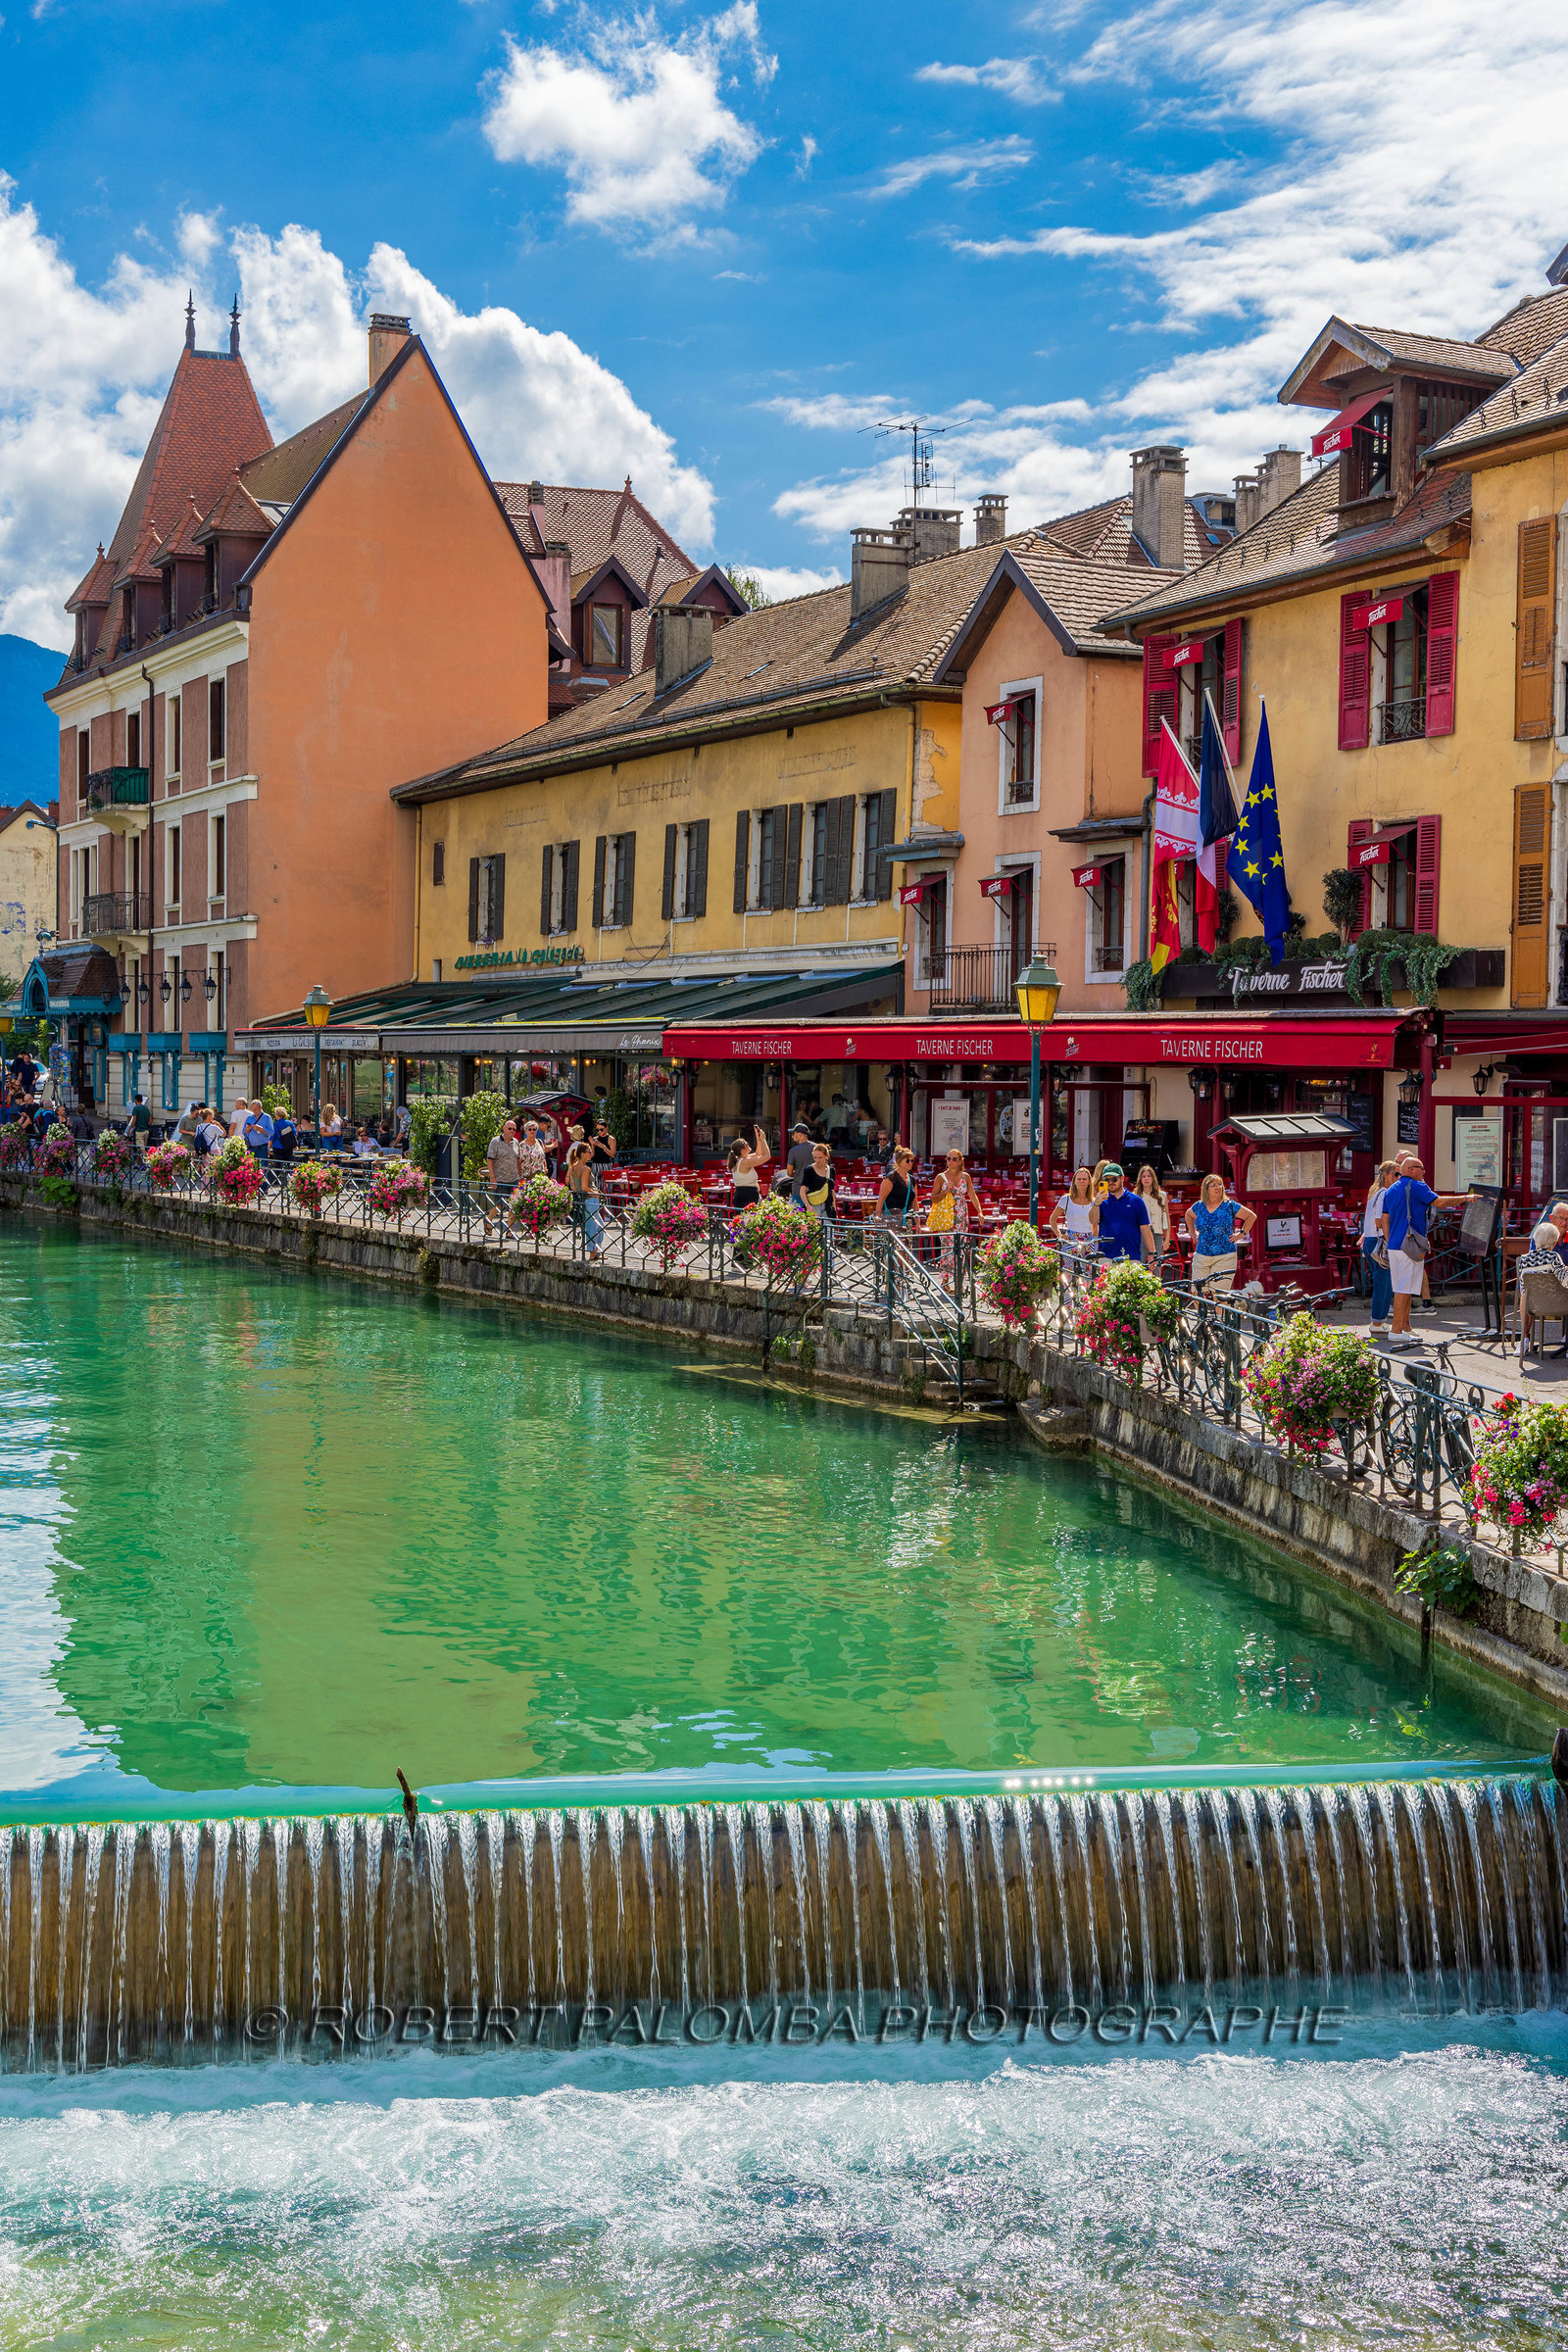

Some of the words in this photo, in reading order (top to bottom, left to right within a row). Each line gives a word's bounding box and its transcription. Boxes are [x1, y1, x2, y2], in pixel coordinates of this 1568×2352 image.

[454, 950, 514, 969] PIZZERIA
[1227, 966, 1291, 995] Taverne
[1298, 960, 1348, 992] Fischer
[619, 1033, 630, 1048] Le
[732, 1041, 762, 1055] TAVERNE
[763, 1041, 792, 1055] FISCHER
[916, 1039, 955, 1055] TAVERNE
[956, 1039, 994, 1055] FISCHER
[1160, 1039, 1211, 1058] TAVERNE
[1214, 1040, 1263, 1059] FISCHER
[1127, 1068, 1132, 1078] 2
